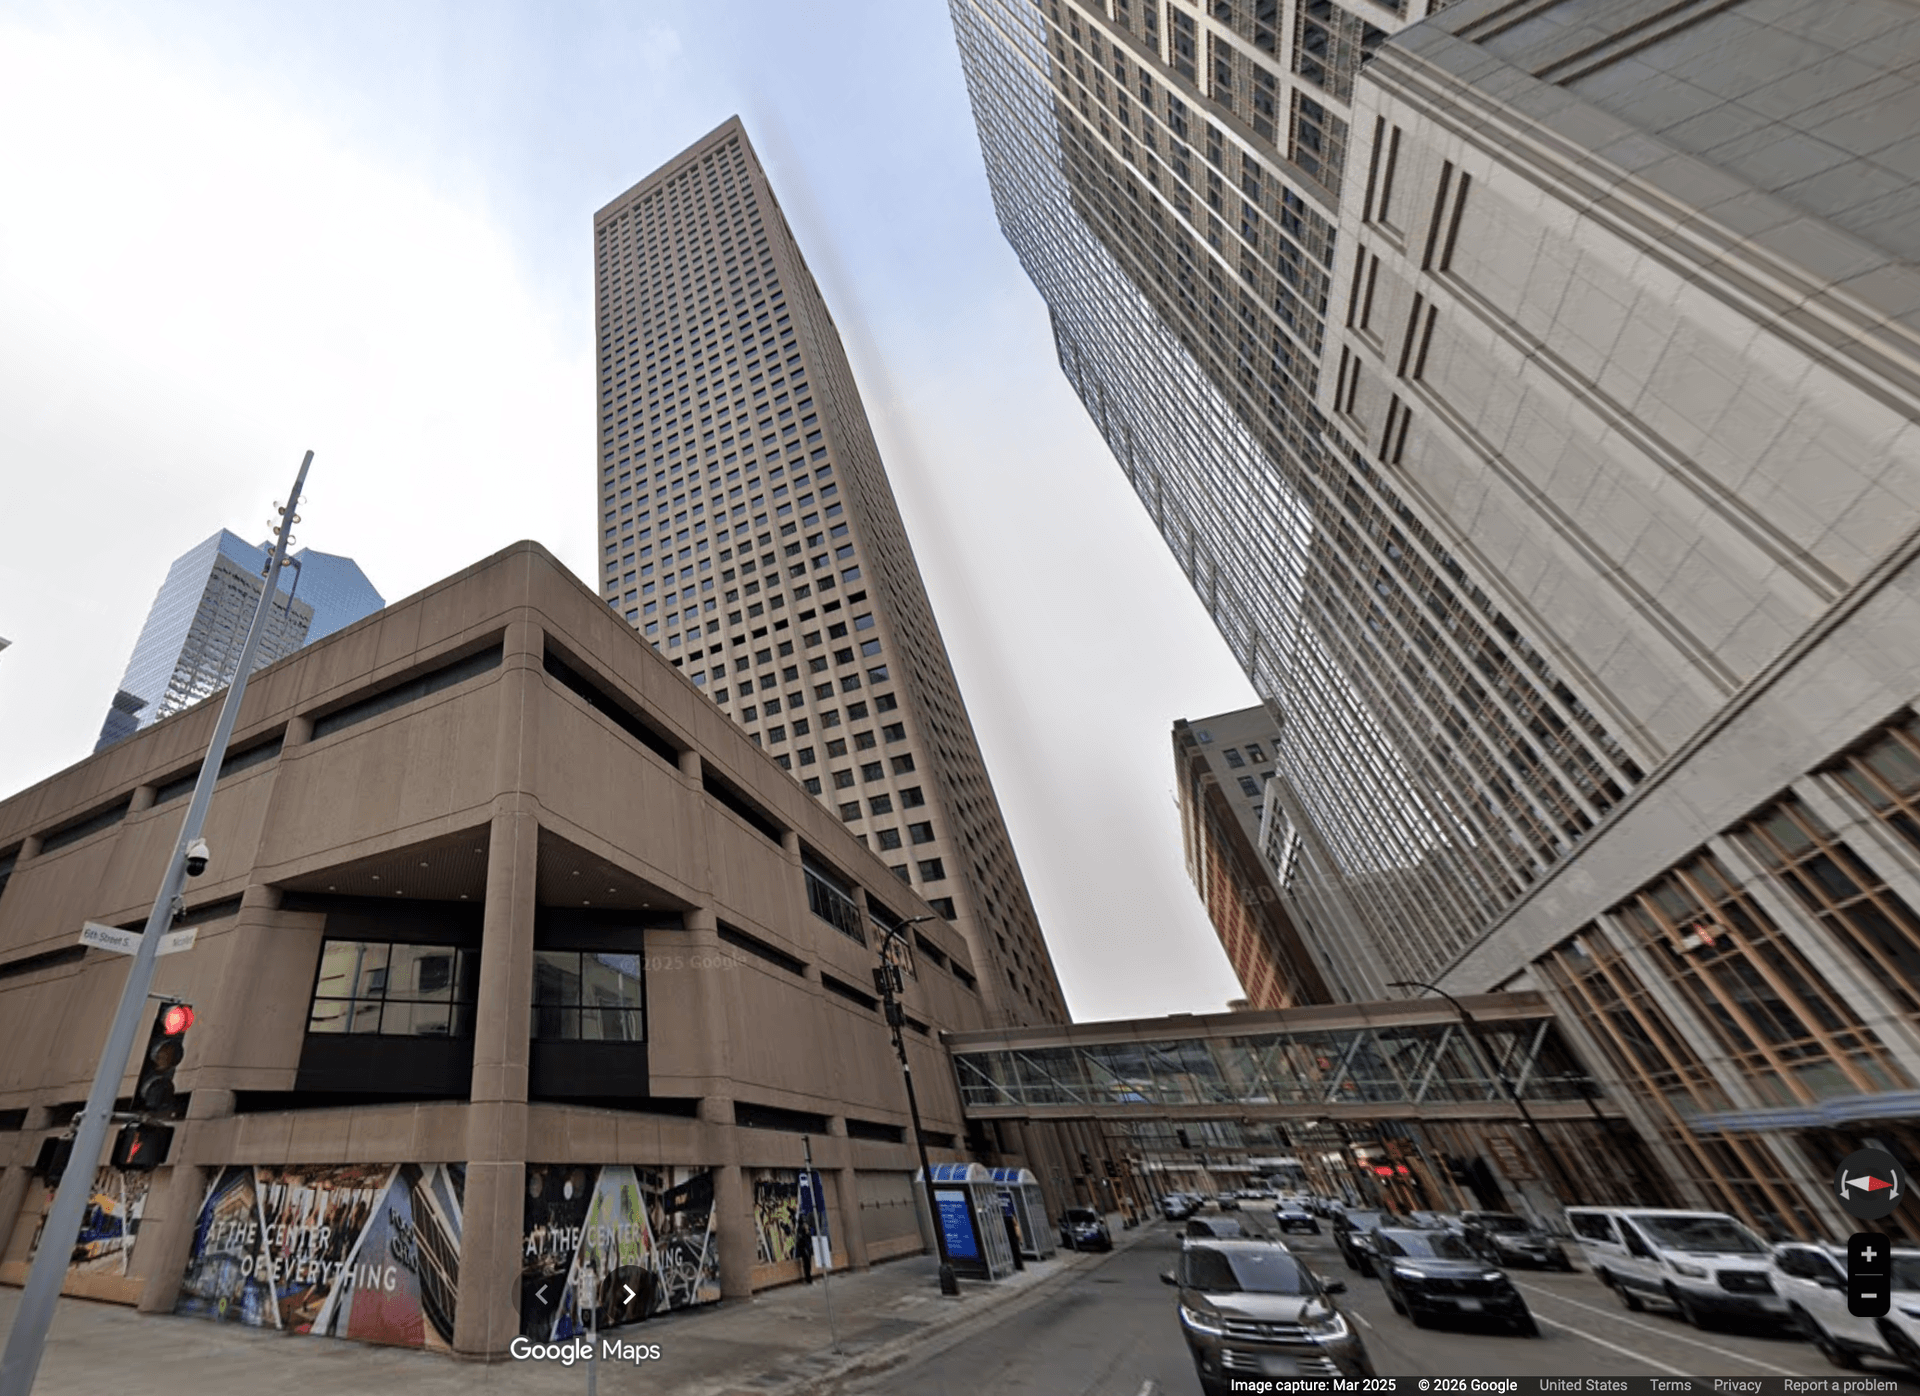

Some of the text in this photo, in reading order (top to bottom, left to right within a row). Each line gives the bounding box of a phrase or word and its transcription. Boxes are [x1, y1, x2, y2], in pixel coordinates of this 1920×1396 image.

[84, 928, 98, 940] 6th
[99, 932, 123, 945] Street
[205, 1221, 332, 1250] AT THE CENTER
[525, 1222, 643, 1258] AT THE CENTER
[241, 1254, 398, 1292] OF EVERYTHING
